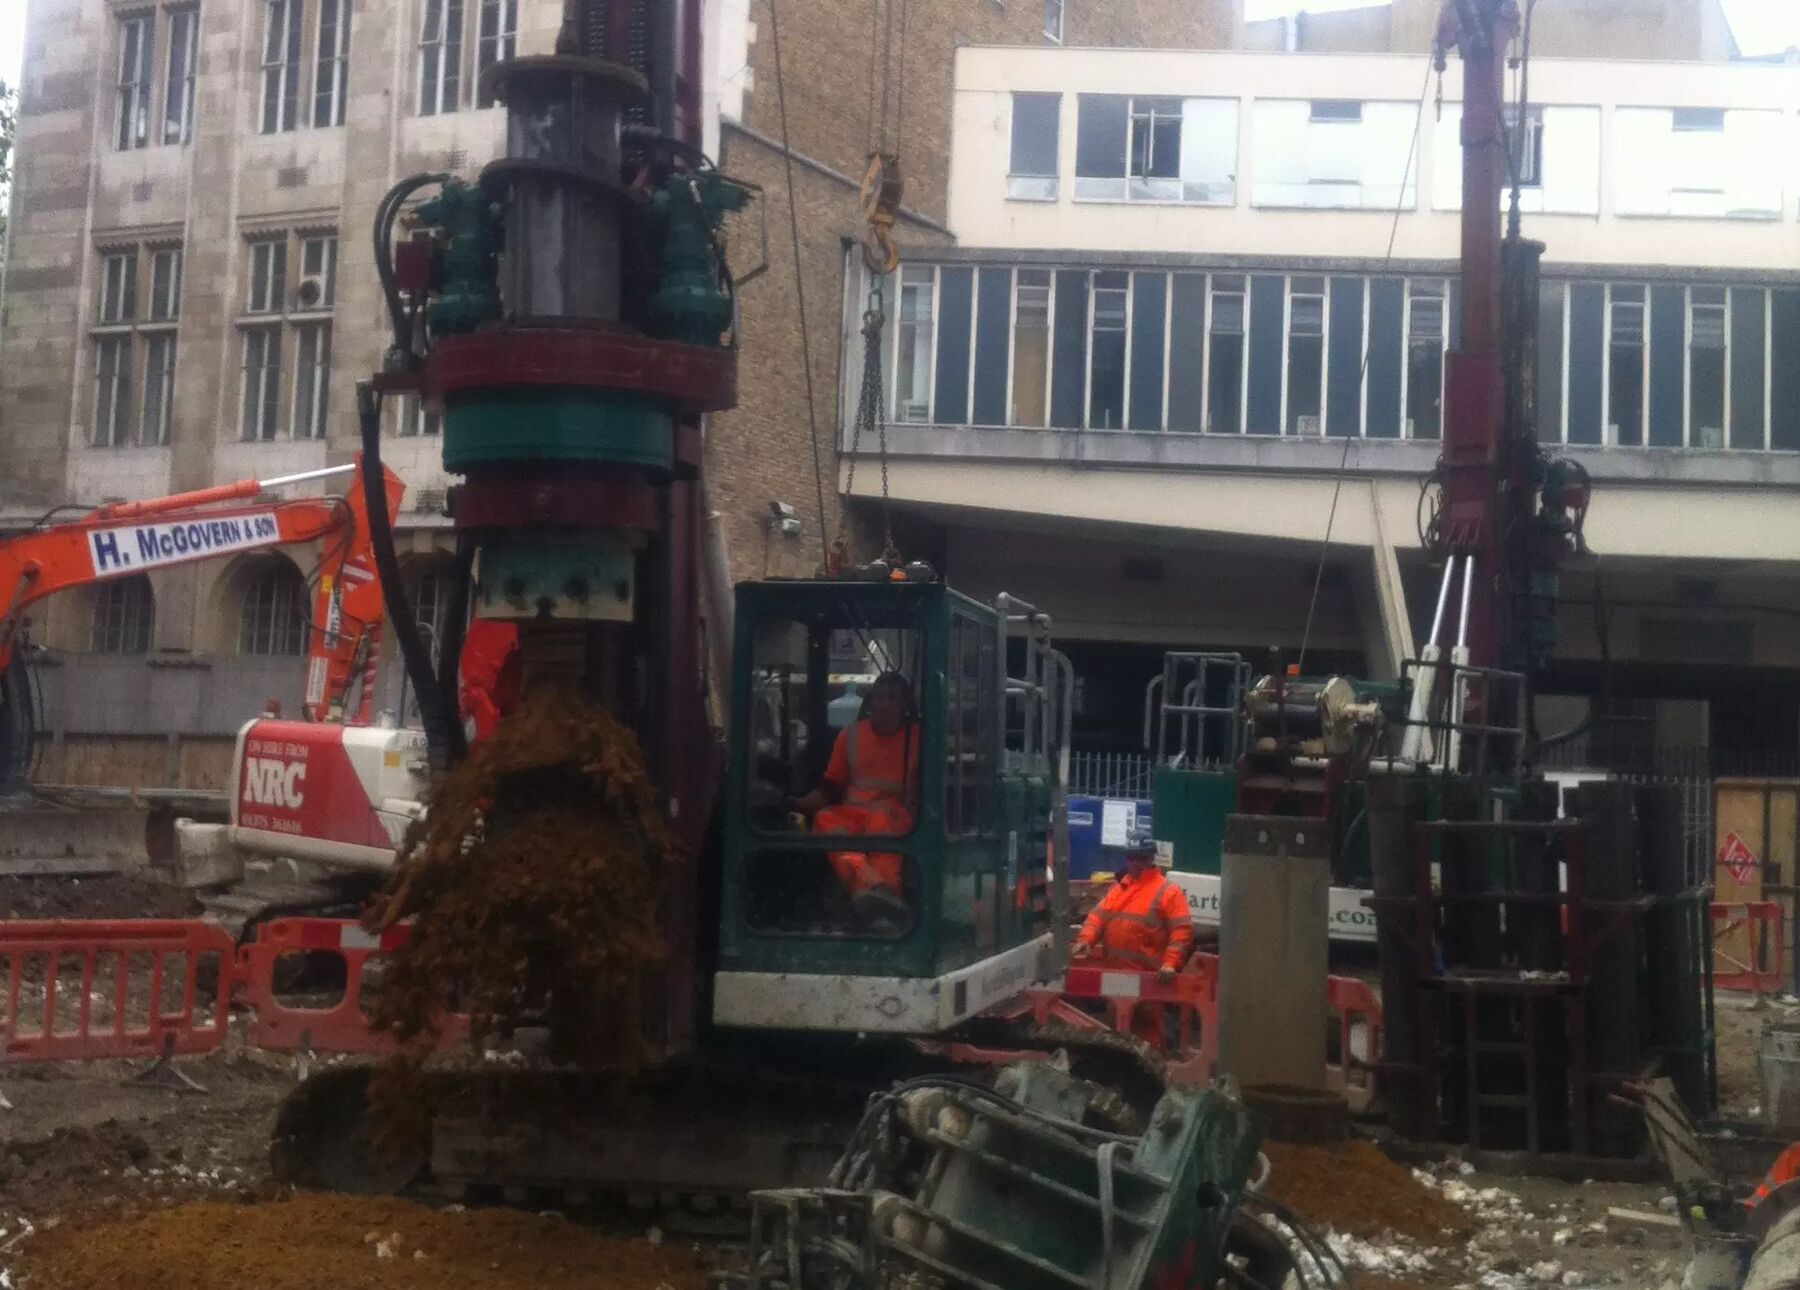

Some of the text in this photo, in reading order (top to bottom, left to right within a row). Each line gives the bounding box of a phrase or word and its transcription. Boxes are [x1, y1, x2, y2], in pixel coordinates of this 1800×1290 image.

[94, 516, 277, 569] H. McGOVERN & SON
[243, 757, 306, 809] NRC
